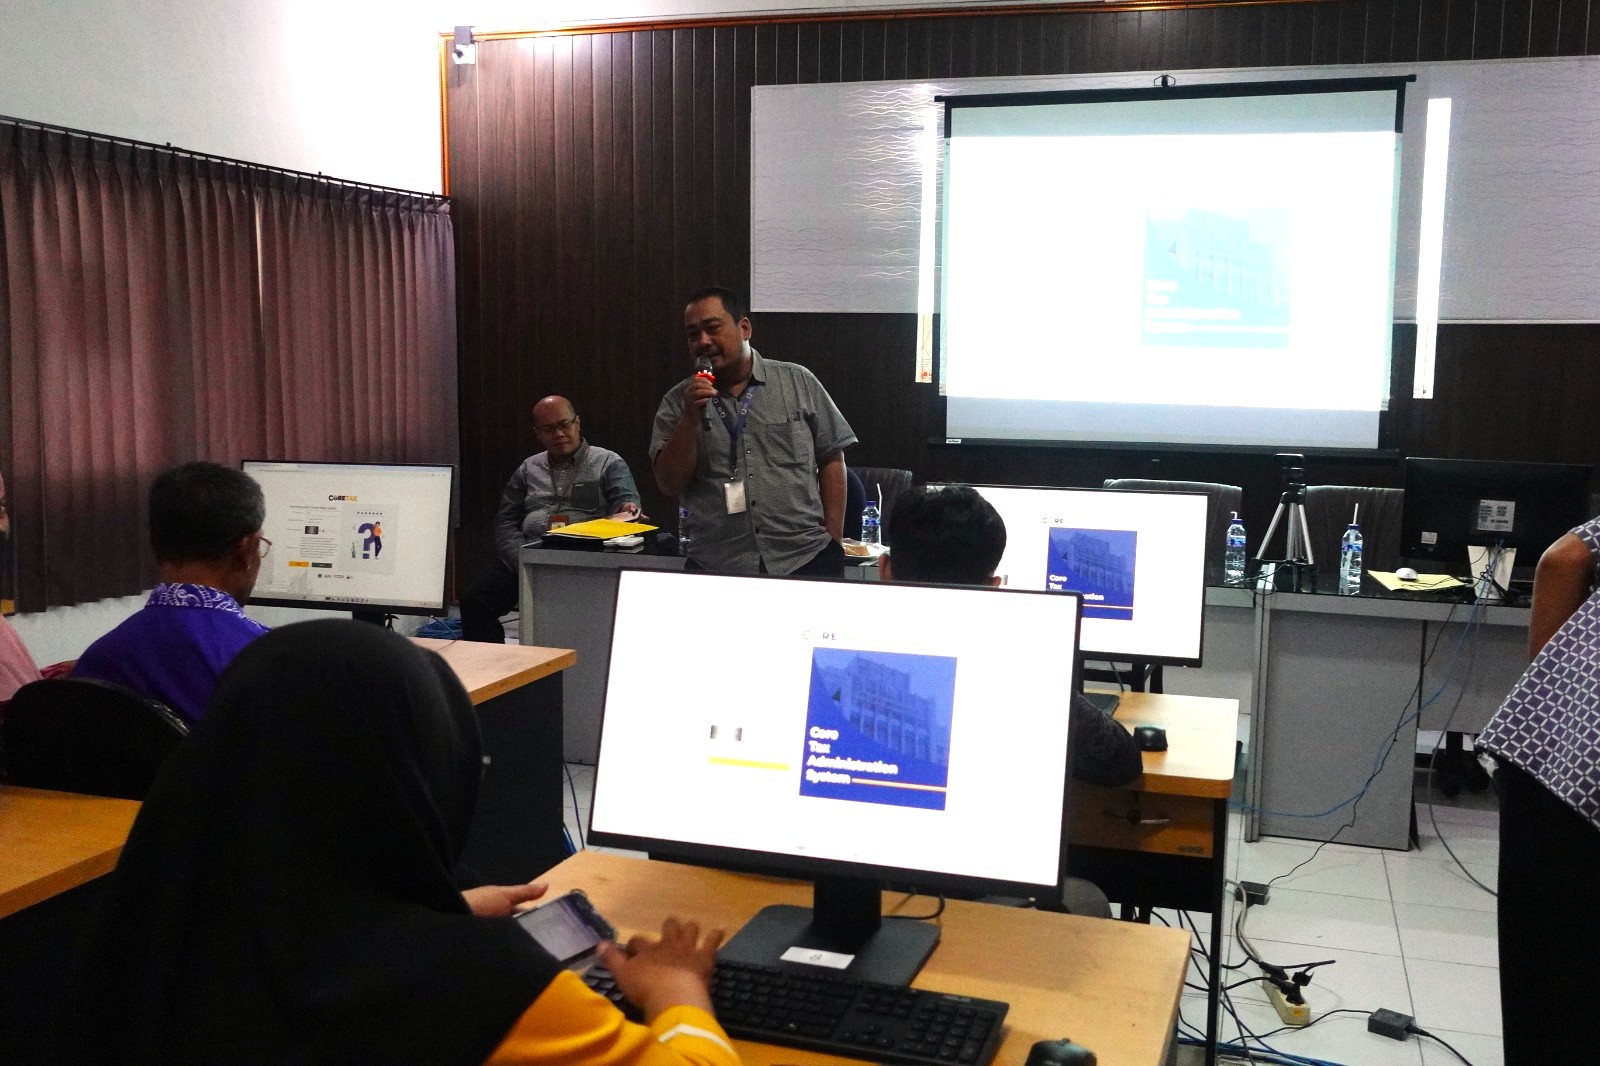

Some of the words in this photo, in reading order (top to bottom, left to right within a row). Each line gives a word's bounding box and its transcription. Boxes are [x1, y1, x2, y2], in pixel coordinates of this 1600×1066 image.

[1050, 574, 1067, 582] Core
[810, 726, 839, 740] Core
[808, 740, 830, 753] Tax
[806, 755, 898, 774] Administration
[806, 768, 850, 784] System
